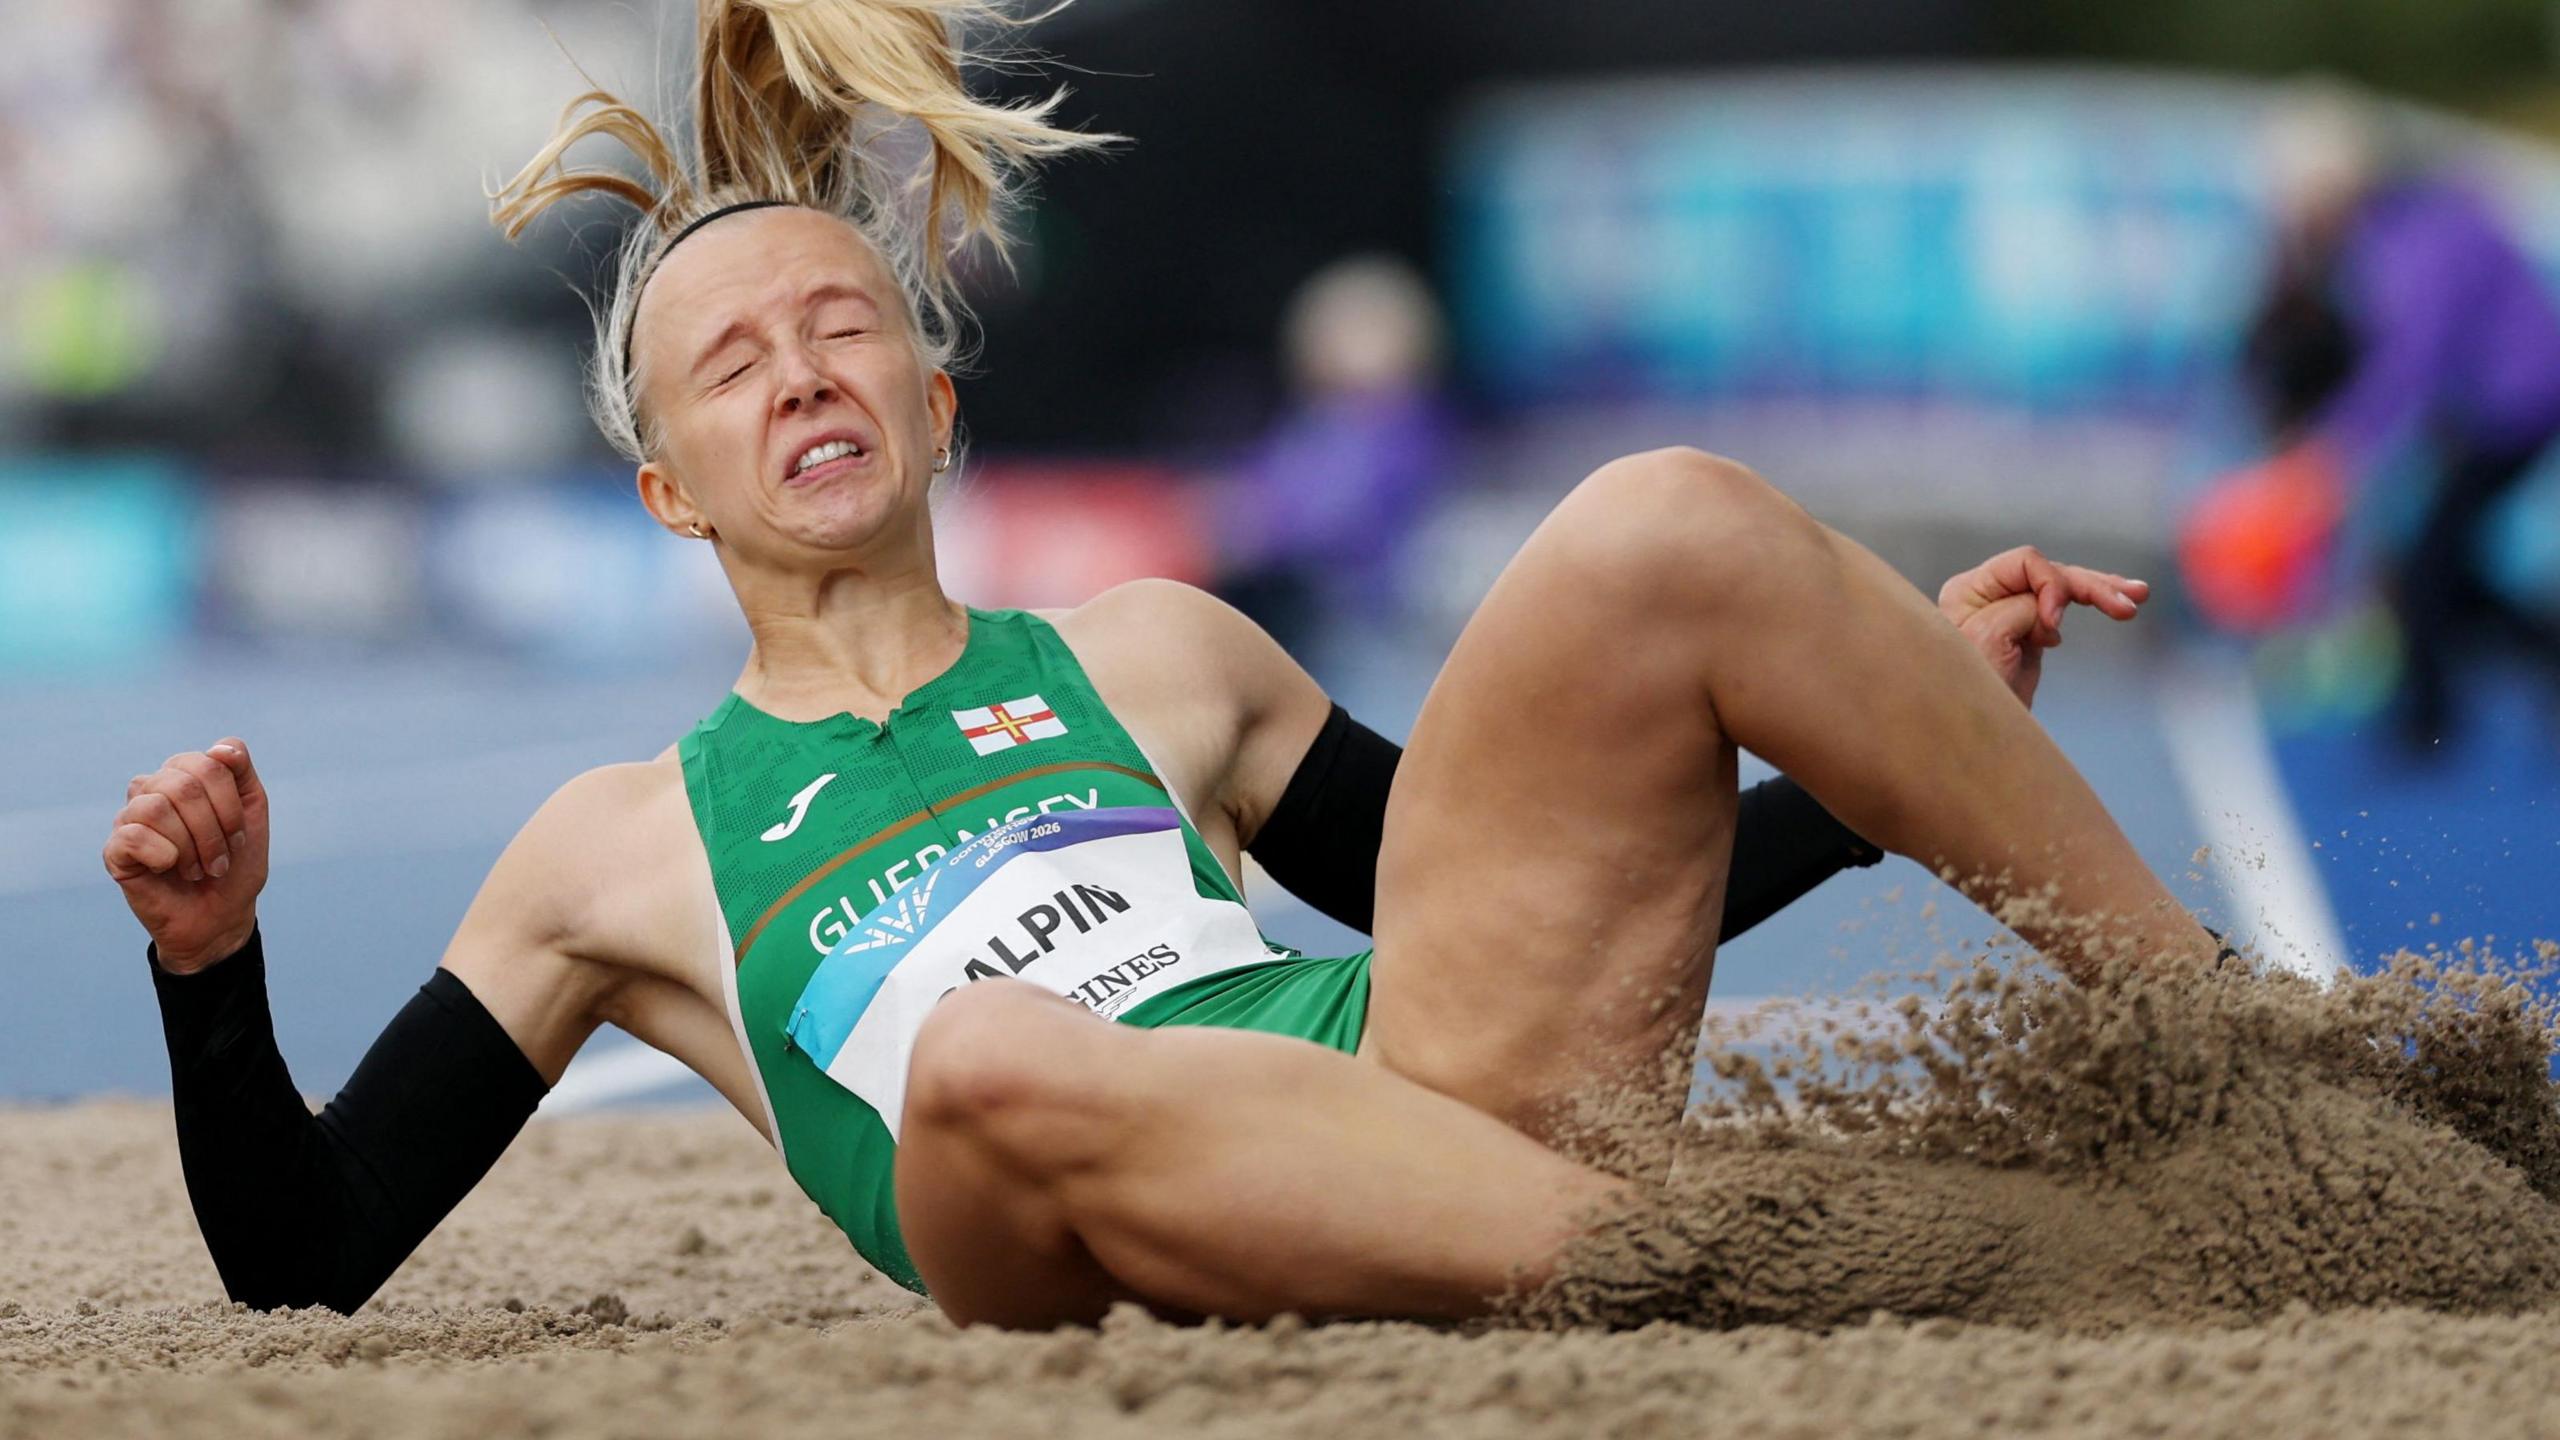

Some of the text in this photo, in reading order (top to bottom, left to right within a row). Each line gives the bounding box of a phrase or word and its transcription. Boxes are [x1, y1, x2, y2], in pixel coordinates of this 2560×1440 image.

[808, 788, 1098, 955] GUEY
[975, 830, 1028, 868] GLASGOW
[1031, 822, 1062, 840] 2026
[936, 884, 1132, 1003] ALPIN
